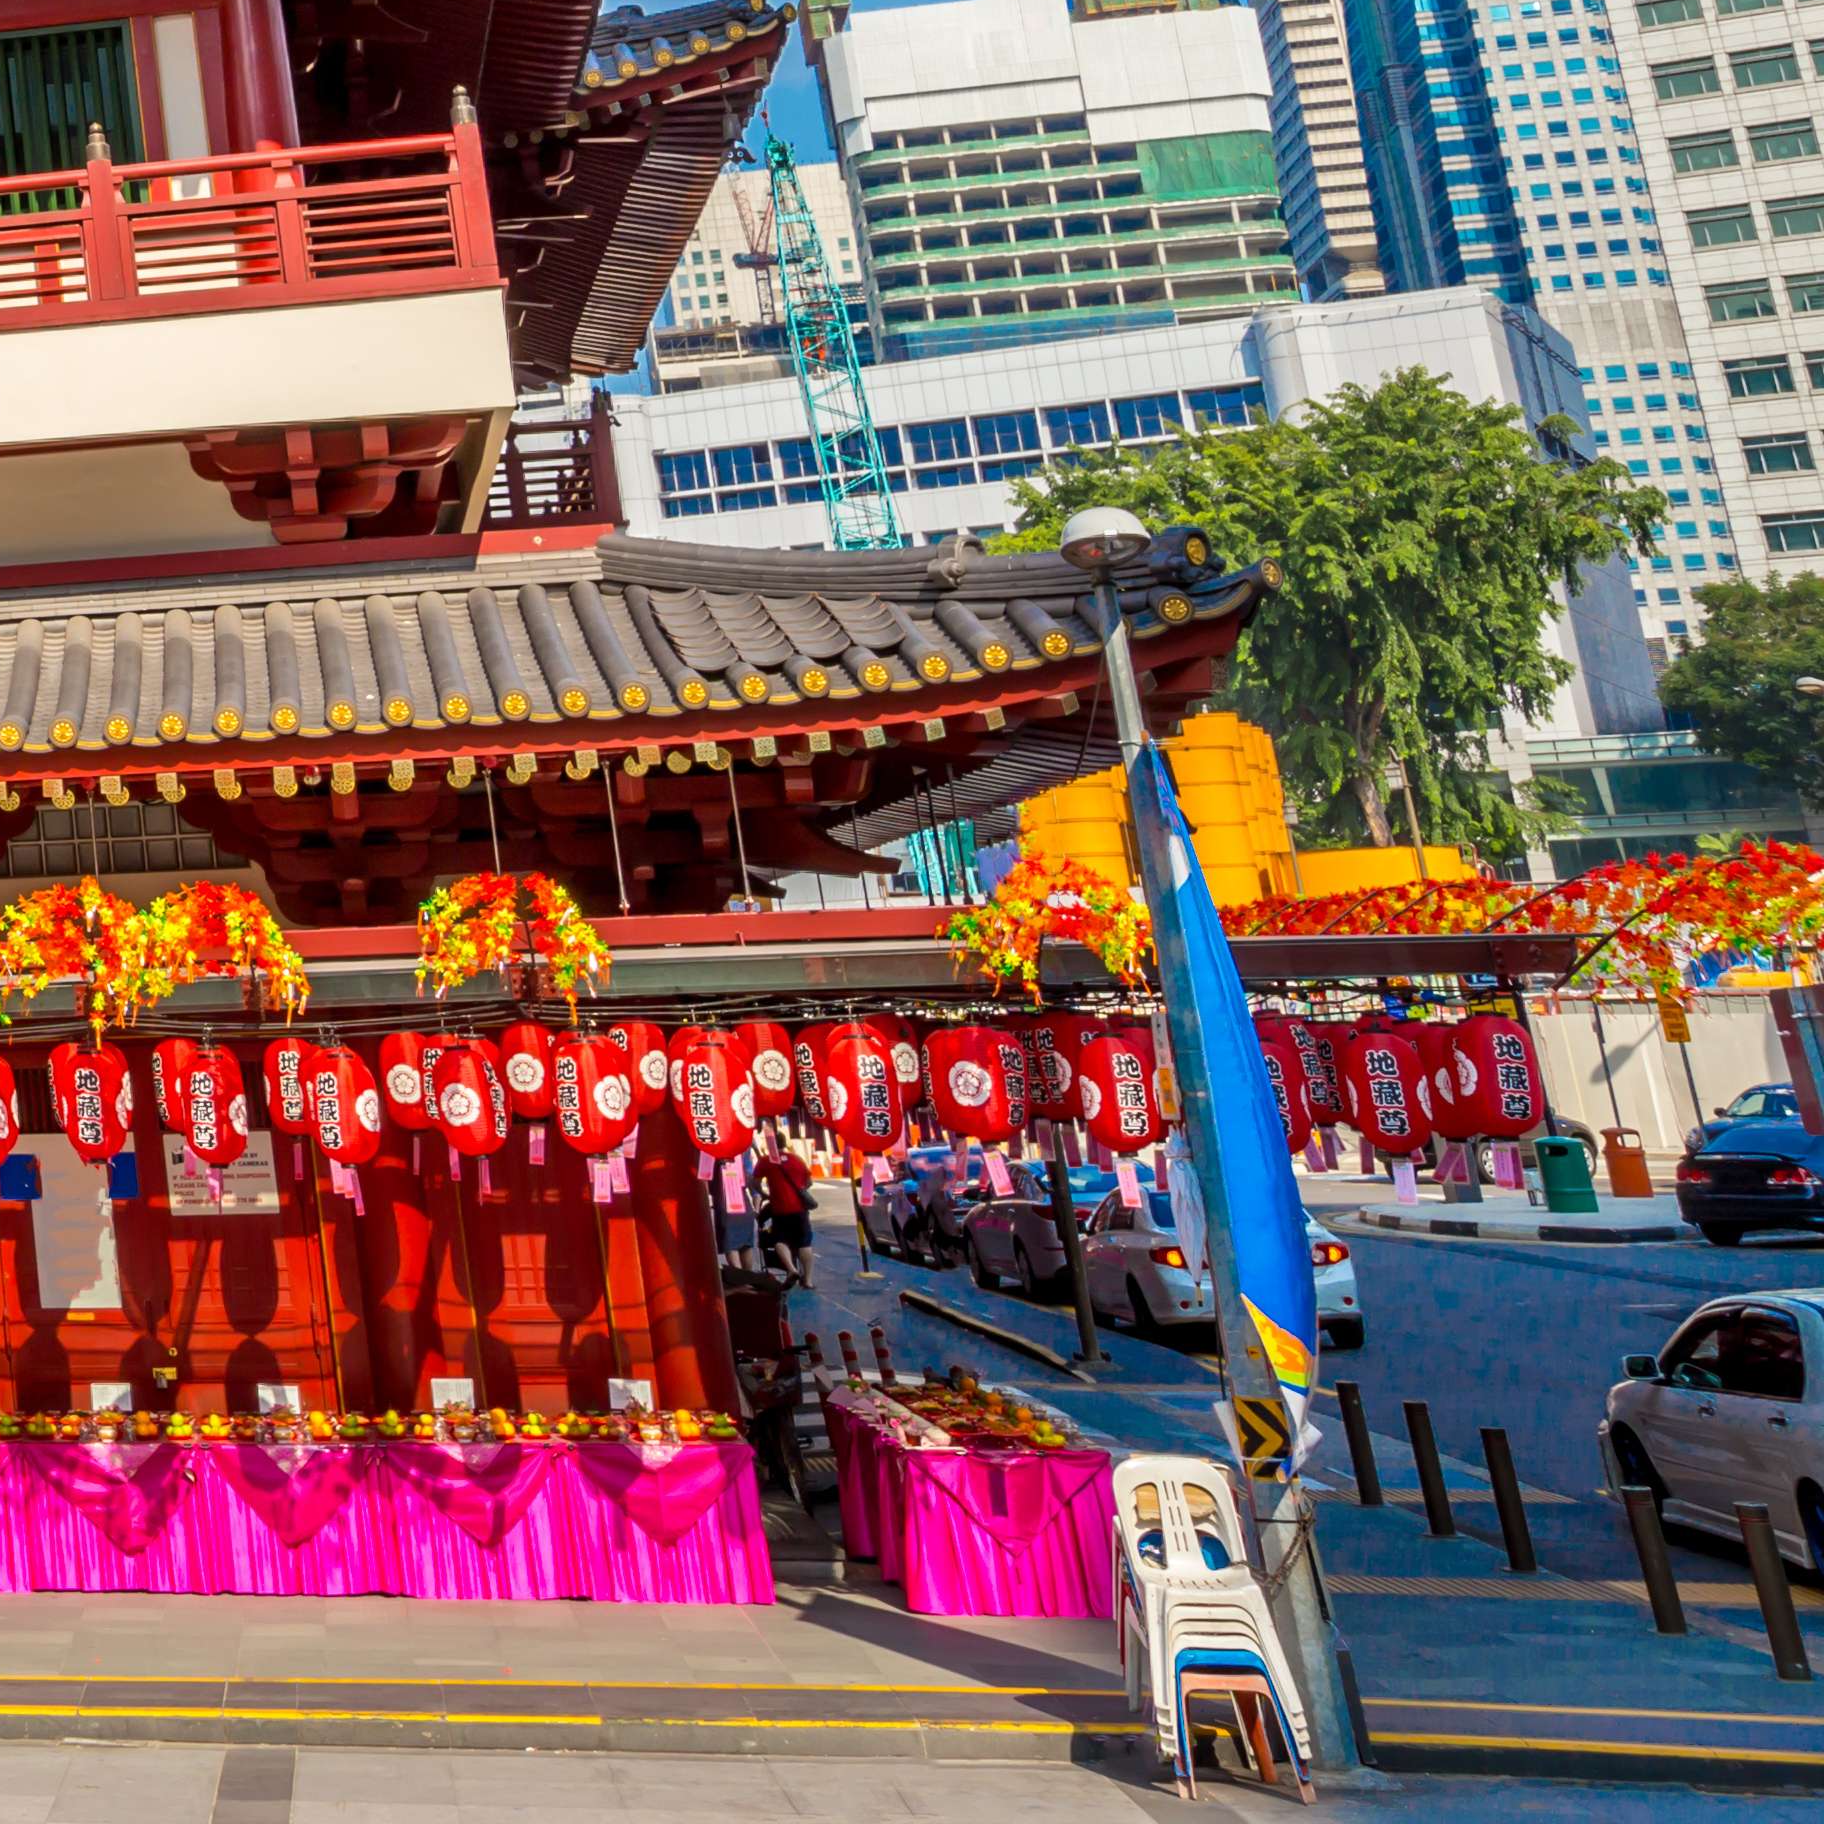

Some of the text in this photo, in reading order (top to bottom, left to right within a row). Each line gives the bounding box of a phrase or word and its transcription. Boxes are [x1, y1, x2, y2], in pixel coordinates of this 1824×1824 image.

[279, 1052, 303, 1120] 地藏尊
[556, 1058, 581, 1136] 地藏尊
[794, 1043, 825, 1118] 地藏尊
[859, 1055, 891, 1135] 地藏尊
[1000, 1045, 1026, 1124] 地藏尊
[1113, 1054, 1150, 1136] 地藏尊
[1290, 1026, 1328, 1104] 地藏尊
[1366, 1051, 1408, 1135] 地藏尊
[1494, 1035, 1531, 1118] 地藏尊
[76, 1069, 103, 1144] 地藏尊
[192, 1074, 217, 1149] 地藏尊
[317, 1073, 342, 1148] 地藏尊
[689, 1065, 719, 1144] 地藏尊
